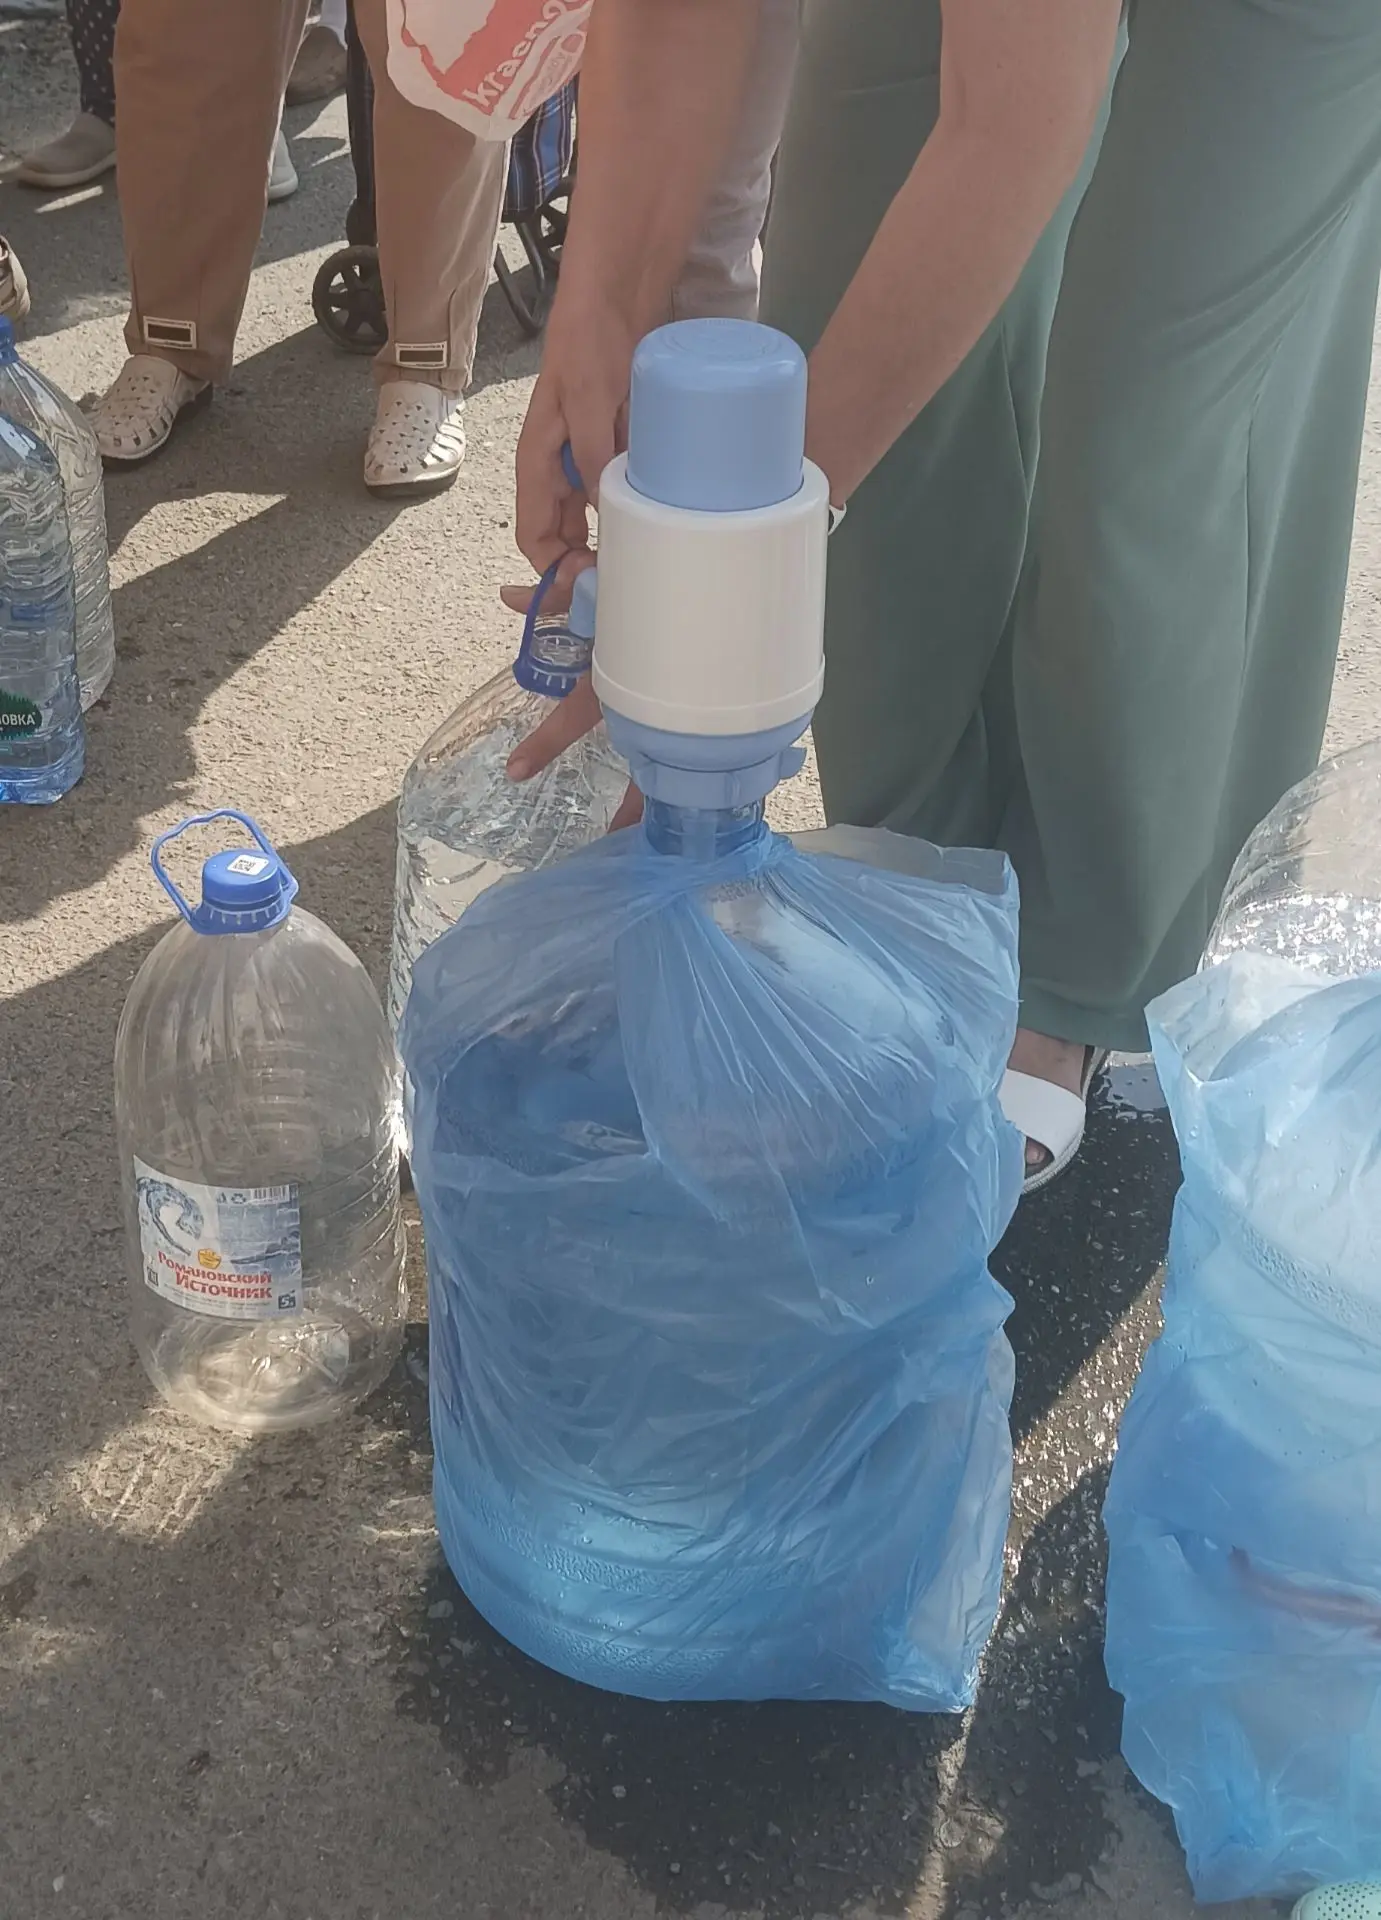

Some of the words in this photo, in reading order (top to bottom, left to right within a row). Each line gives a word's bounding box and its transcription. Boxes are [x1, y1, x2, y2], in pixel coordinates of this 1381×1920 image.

[0, 713, 36, 726] ОВКА
[158, 1250, 273, 1285] Романовский
[176, 1272, 273, 1299] Источник
